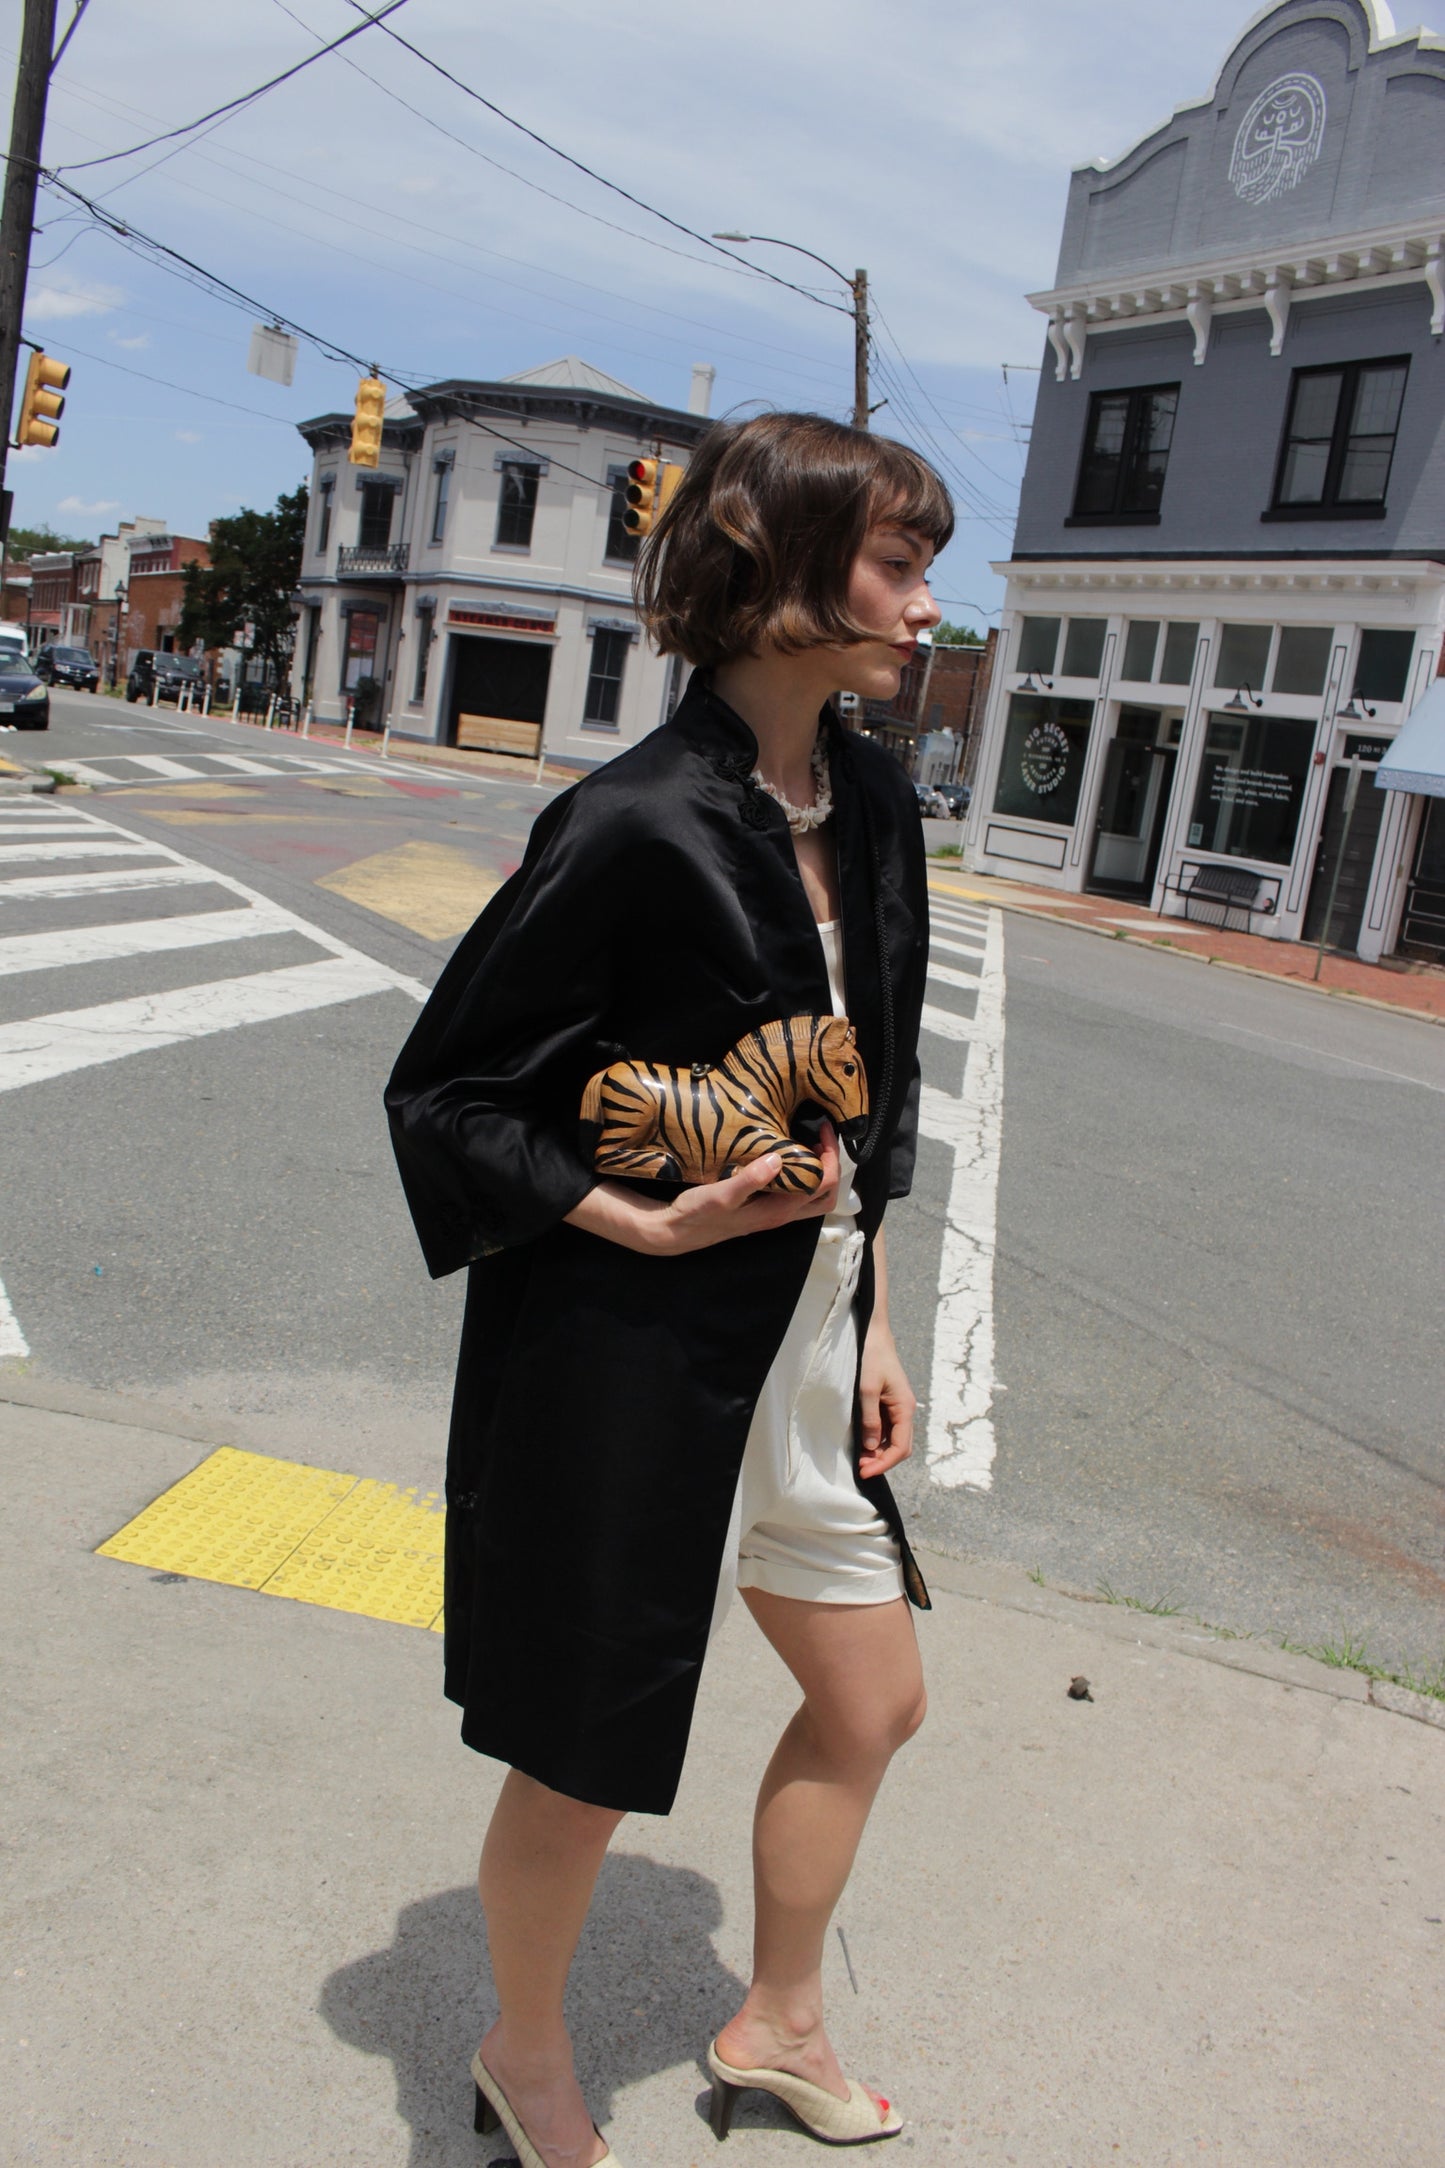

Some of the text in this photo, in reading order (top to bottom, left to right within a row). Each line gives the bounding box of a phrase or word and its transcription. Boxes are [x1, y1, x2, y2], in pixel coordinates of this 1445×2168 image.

[1044, 722, 1069, 752] SECRET
[1021, 761, 1066, 794] LASER STUDIO
